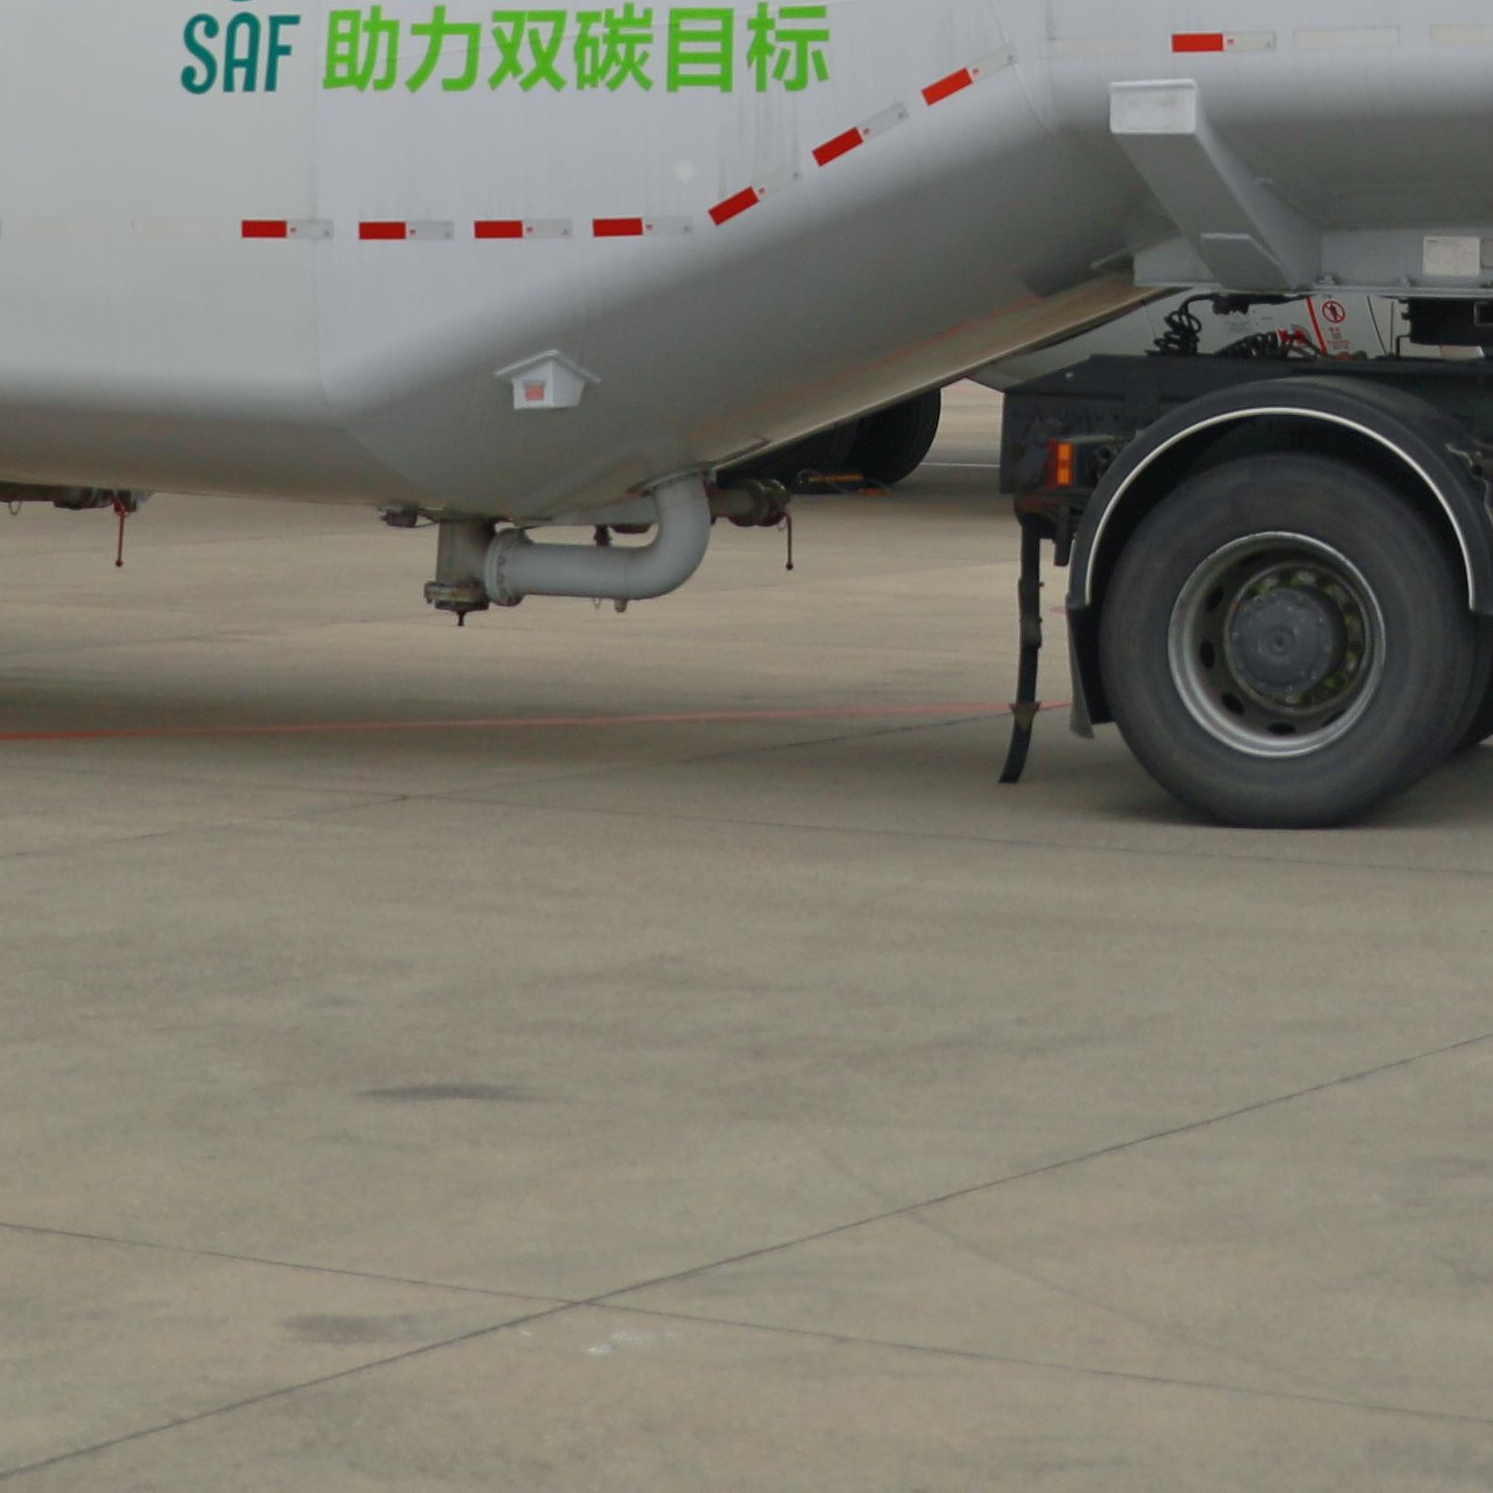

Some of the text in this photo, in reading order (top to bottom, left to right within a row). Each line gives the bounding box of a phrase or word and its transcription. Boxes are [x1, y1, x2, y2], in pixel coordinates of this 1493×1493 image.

[181, 12, 301, 95] SAF
[322, 3, 830, 94] 助力双碳目标
